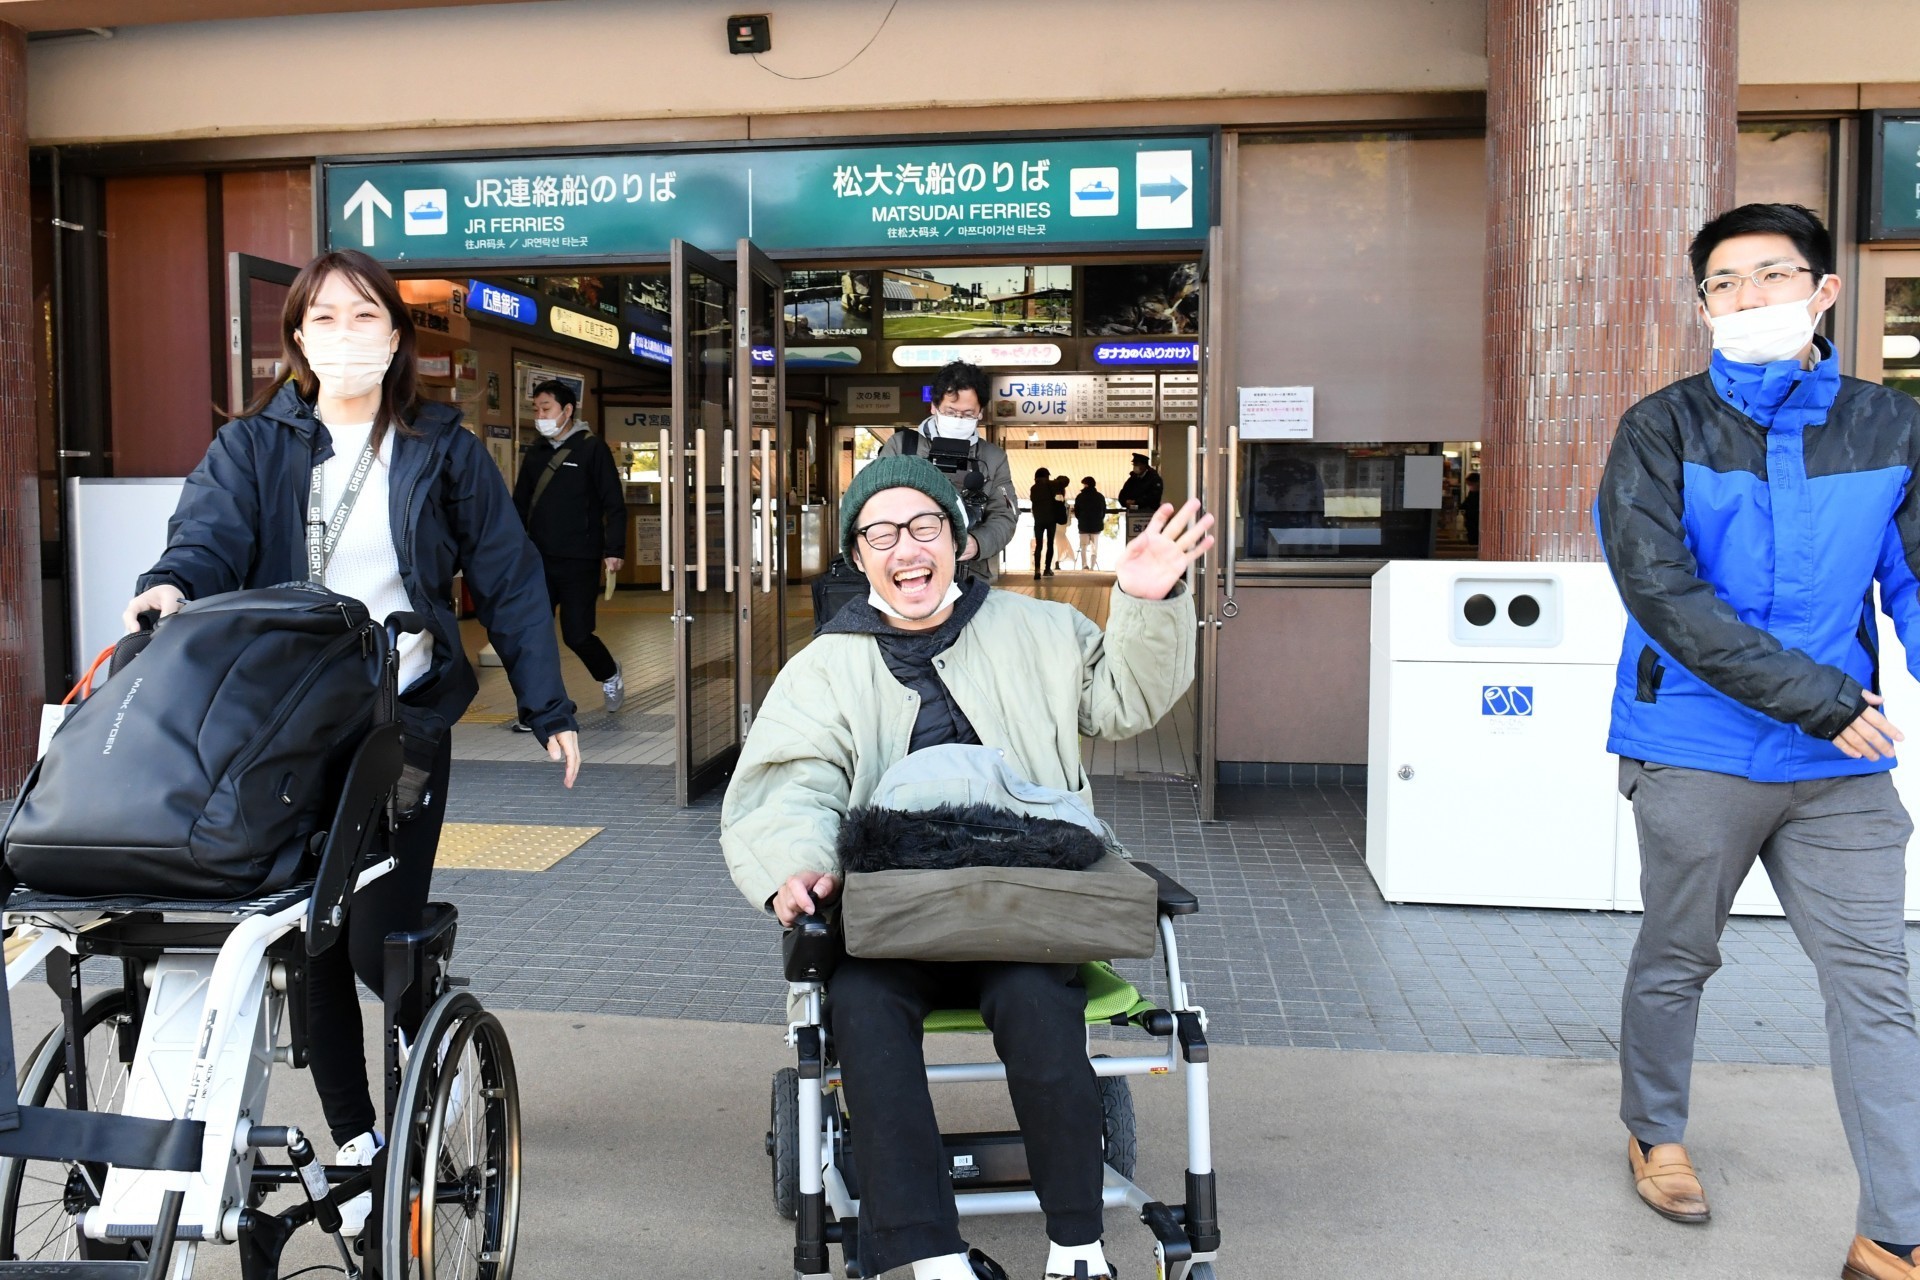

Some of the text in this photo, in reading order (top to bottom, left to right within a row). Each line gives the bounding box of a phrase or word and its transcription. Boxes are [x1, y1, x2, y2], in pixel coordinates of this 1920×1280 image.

[832, 158, 1051, 198] 松大汽船のりば
[464, 171, 677, 209] JR連絡船のりば
[872, 202, 1051, 222] MATSUDAI FERRIES
[465, 216, 565, 235] JR FERRIES
[887, 226, 940, 239] 往松大码头
[958, 224, 1016, 237] 마쯔다이기선
[1017, 223, 1047, 236] 타는곳
[465, 238, 506, 250] 往JR码头
[522, 238, 560, 249] JR연락선
[561, 236, 588, 248] 타는곳
[482, 287, 520, 318] 広島銀行
[856, 391, 891, 400] 次の発船
[1000, 382, 1067, 397] JR連絡船
[1022, 400, 1067, 415] のりば
[349, 444, 374, 492] GREGORY
[310, 524, 322, 577] GREGORY
[102, 677, 143, 755] MARK RYDEN
